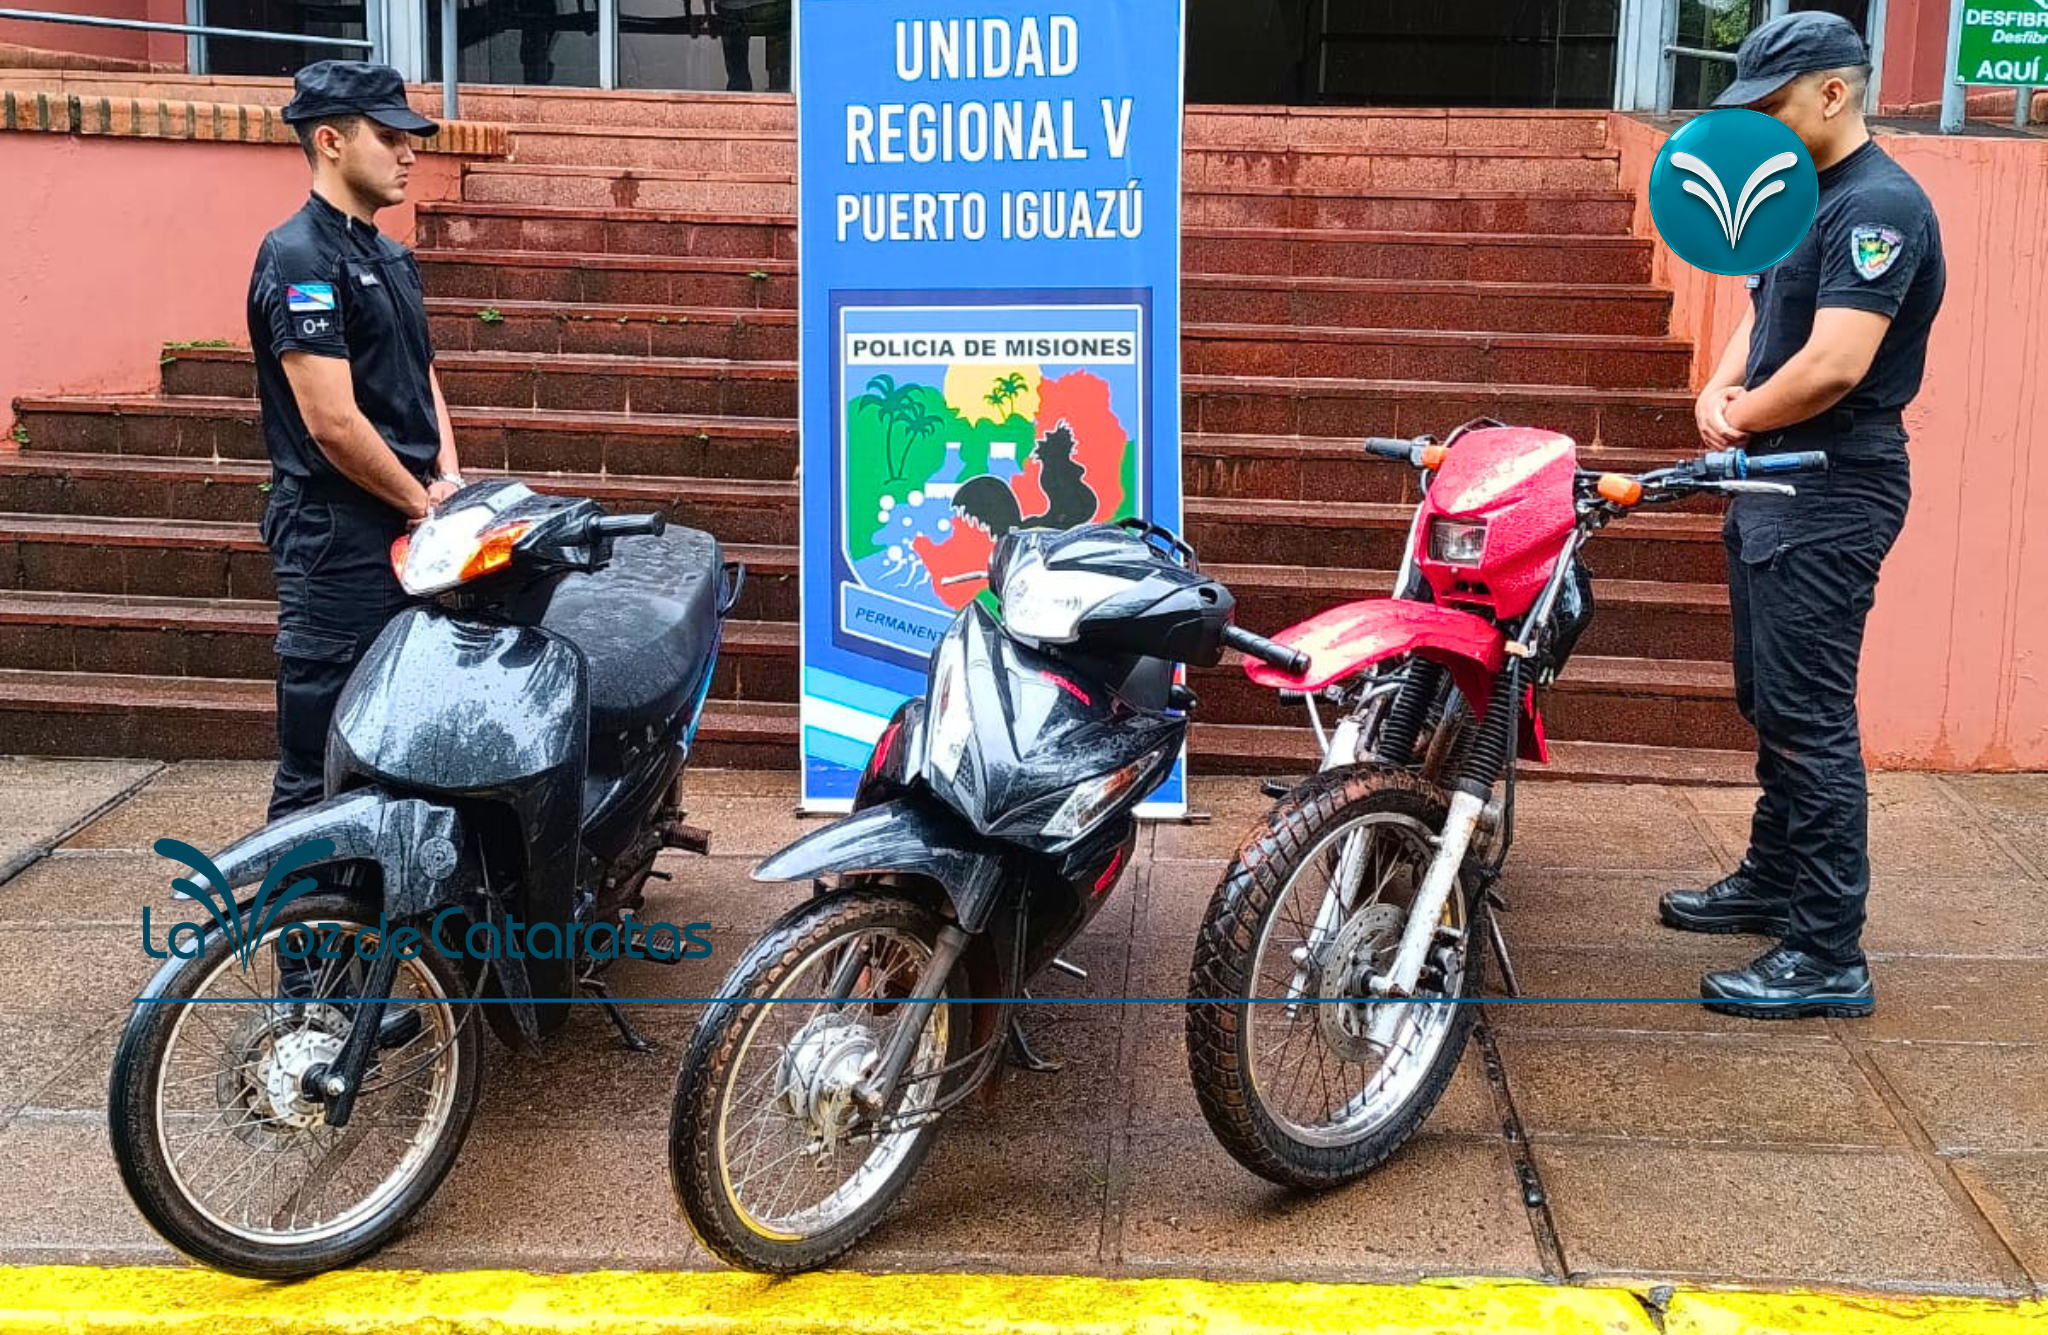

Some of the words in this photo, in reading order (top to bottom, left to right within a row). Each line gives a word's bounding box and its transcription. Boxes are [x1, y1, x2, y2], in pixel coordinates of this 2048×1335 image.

[895, 15, 1079, 81] UNIDAD
[1976, 56, 2041, 81] AQUÍ
[846, 99, 1088, 164] REGIONAL
[1101, 98, 1133, 159] V
[837, 191, 987, 242] PUERTO
[1001, 178, 1144, 240] IGUAZÚ
[853, 339, 955, 357] POLICIA
[964, 339, 996, 356] DE
[1006, 338, 1132, 357] MISIONES
